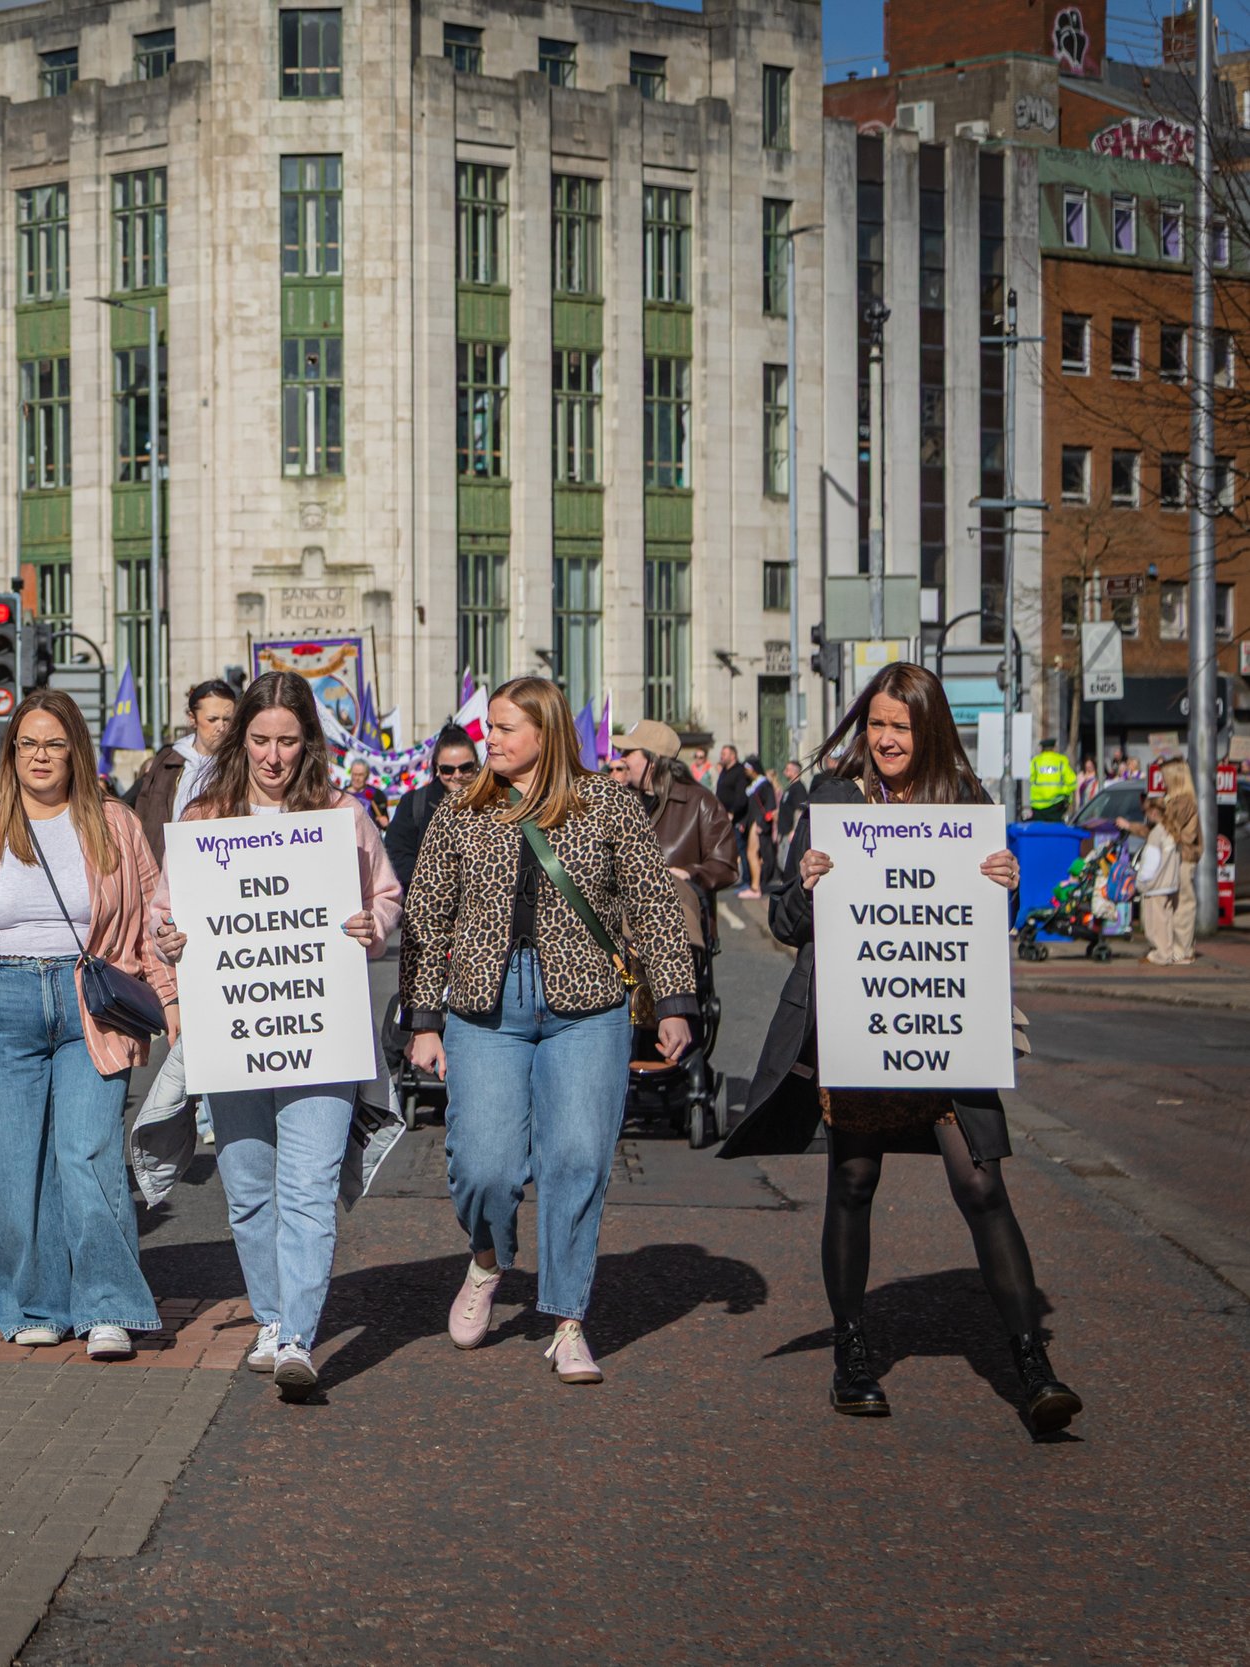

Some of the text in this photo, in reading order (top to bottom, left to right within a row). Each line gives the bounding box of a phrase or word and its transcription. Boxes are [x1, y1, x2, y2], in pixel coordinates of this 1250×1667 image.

[281, 587, 347, 601] BANK OF
[281, 604, 347, 619] IRELAND
[1090, 682, 1118, 695] ENDS
[196, 827, 323, 863] Women's Aid
[842, 821, 973, 850] Women's Aid
[239, 875, 290, 899] END
[885, 868, 936, 889] END
[206, 907, 329, 936] VIOLENCE
[849, 904, 974, 926] VIOLENCE
[216, 942, 326, 971] AGAINST
[856, 940, 970, 962] AGAINST
[221, 977, 325, 1005] WOMEN
[861, 977, 966, 999] WOMEN
[230, 1012, 324, 1040] & GIRLS
[867, 1012, 964, 1036] & GIRLS
[246, 1048, 313, 1074] NOW
[882, 1049, 951, 1072] NOW
